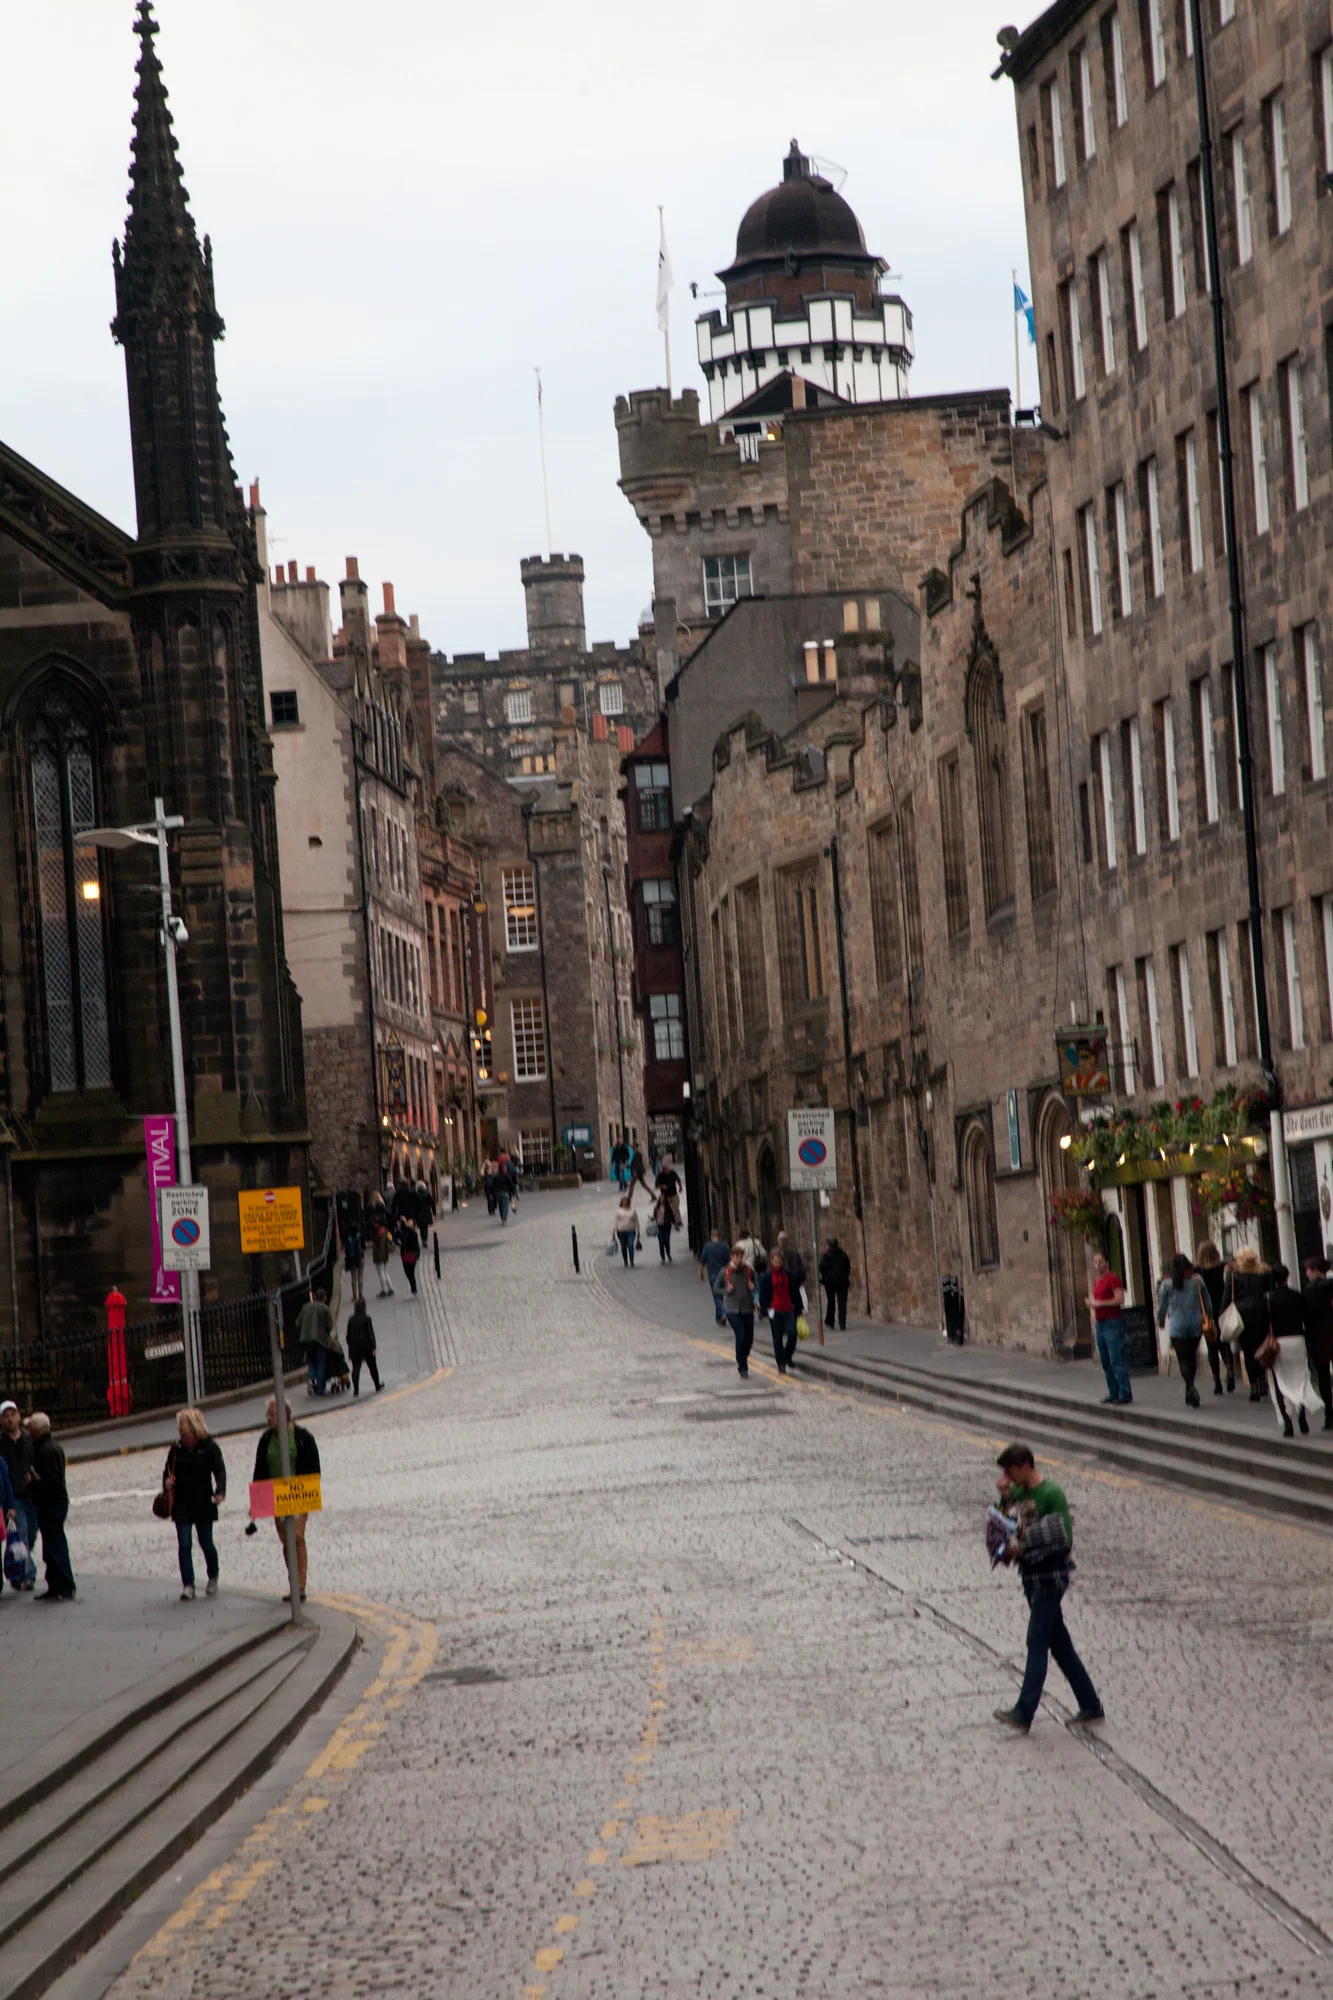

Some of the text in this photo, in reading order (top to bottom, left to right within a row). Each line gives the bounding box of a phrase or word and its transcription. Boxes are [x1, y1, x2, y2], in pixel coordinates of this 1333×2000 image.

[792, 1111, 830, 1119] Restricted
[797, 1120, 825, 1128] parking
[798, 1128, 825, 1136] ZONE
[149, 1121, 172, 1193] TIVAL
[165, 1190, 204, 1198] Restricted
[171, 1200, 198, 1208] parking
[171, 1208, 199, 1216] ZONE
[289, 1481, 305, 1492] NO
[276, 1489, 319, 1502] PARKING
